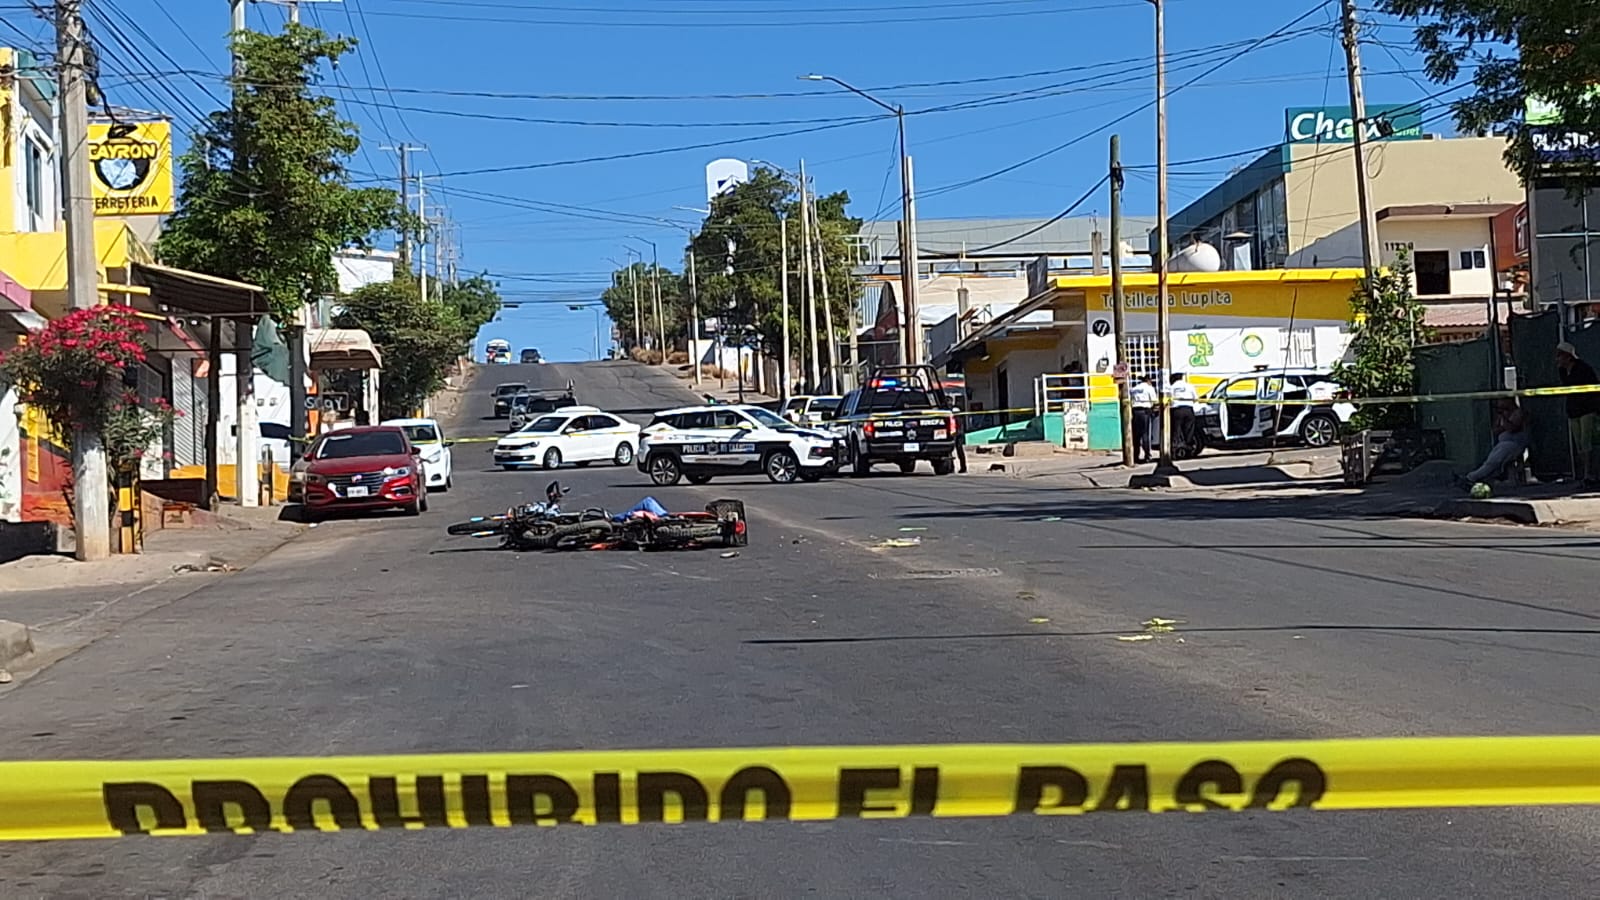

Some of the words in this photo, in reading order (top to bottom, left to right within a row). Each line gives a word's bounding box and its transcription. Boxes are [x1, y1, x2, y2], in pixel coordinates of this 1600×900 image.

[95, 196, 159, 210] ERRETERIA
[1102, 291, 1176, 308] Totillera
[1182, 289, 1232, 307] Lupita
